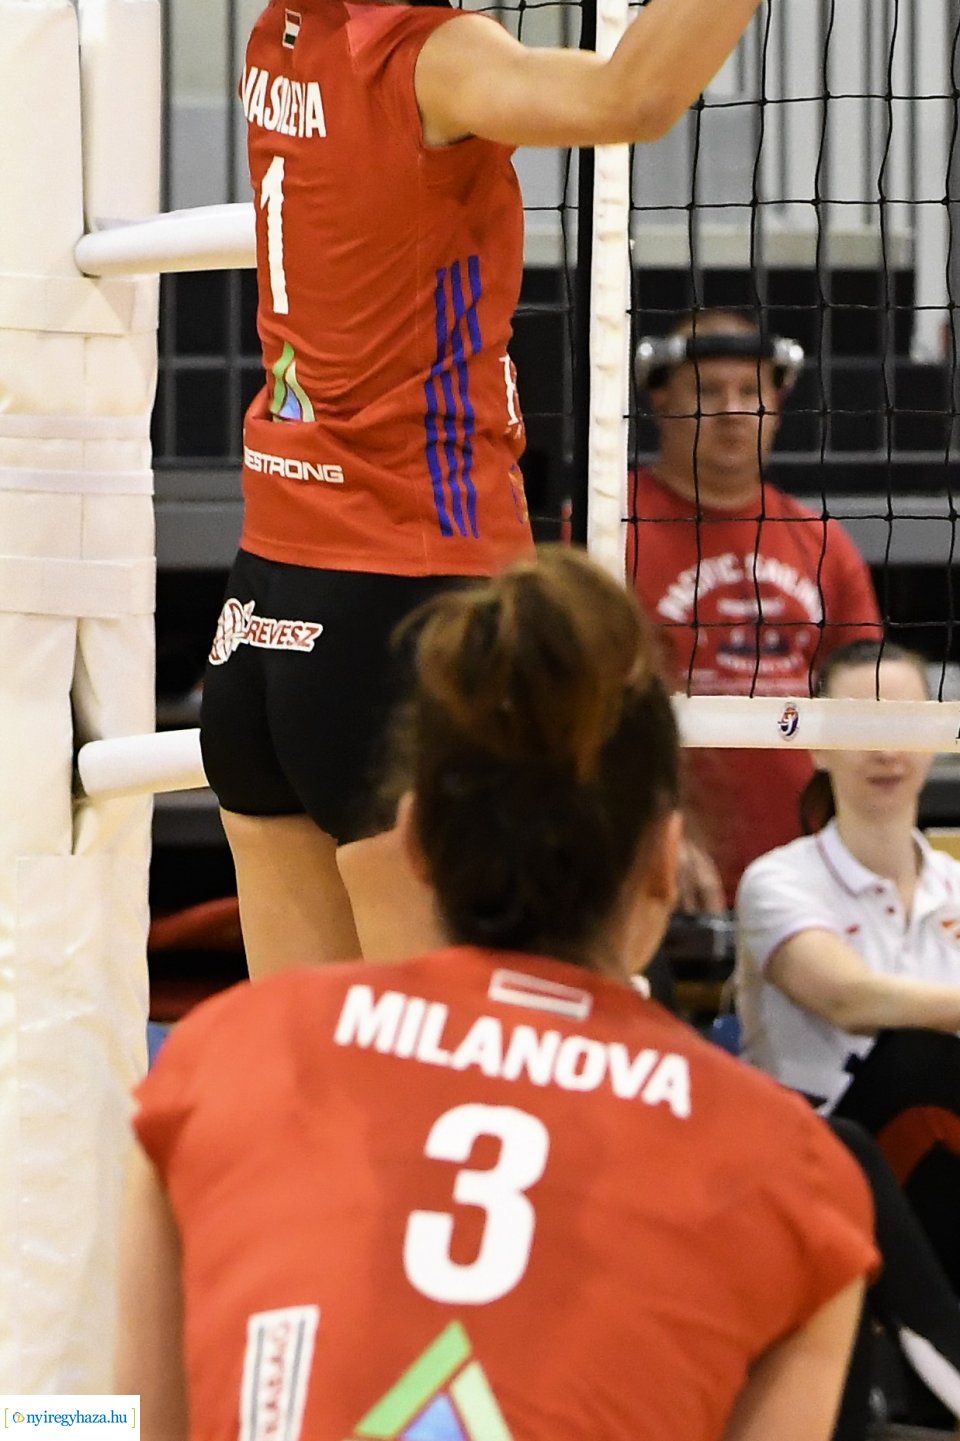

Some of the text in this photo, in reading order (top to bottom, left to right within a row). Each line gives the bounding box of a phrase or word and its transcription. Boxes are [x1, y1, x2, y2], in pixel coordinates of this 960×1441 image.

[260, 156, 289, 315] 1
[334, 984, 692, 1119] MILANOVA
[403, 1103, 551, 1305] 3
